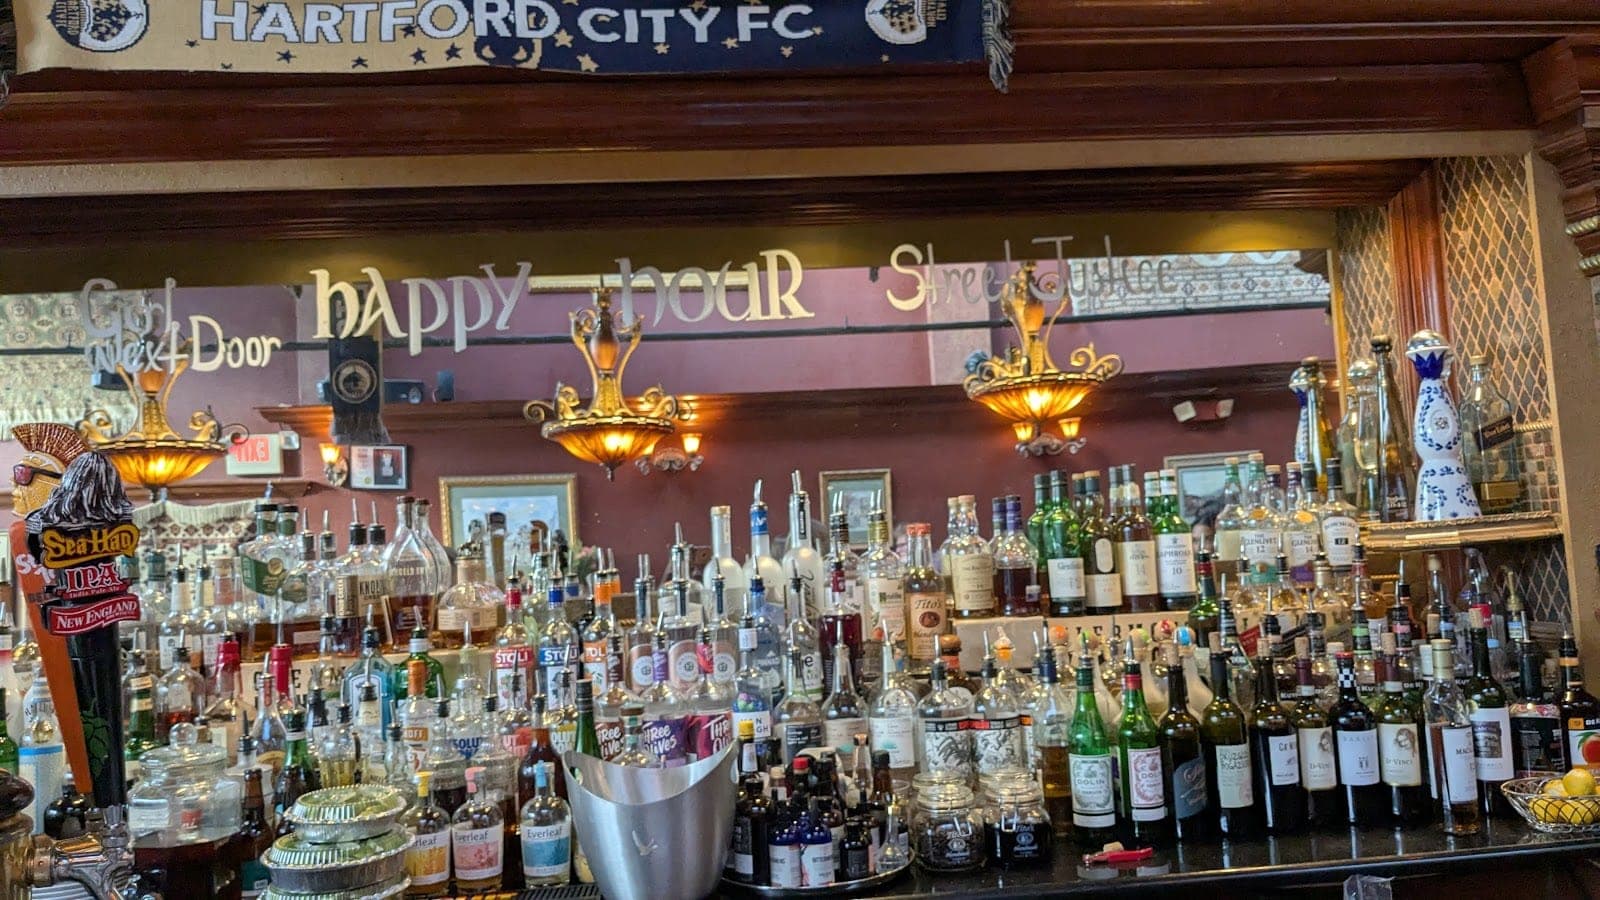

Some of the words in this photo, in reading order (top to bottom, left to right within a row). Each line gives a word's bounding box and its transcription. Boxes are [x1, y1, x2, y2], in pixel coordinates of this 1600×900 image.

[201, 0, 560, 43] HARTFORD
[577, 6, 720, 43] CITY
[738, 5, 813, 42] FC
[886, 240, 1017, 311] Street
[1029, 235, 1179, 301] Justice
[189, 315, 281, 372] Door
[65, 562, 122, 592] IPA
[1172, 567, 1182, 575] 10
[57, 615, 84, 629] NEW
[85, 600, 137, 625] ENGLAND
[496, 651, 528, 663] STOLI
[411, 837, 438, 848] erleaf
[527, 825, 563, 838] Everleaf
